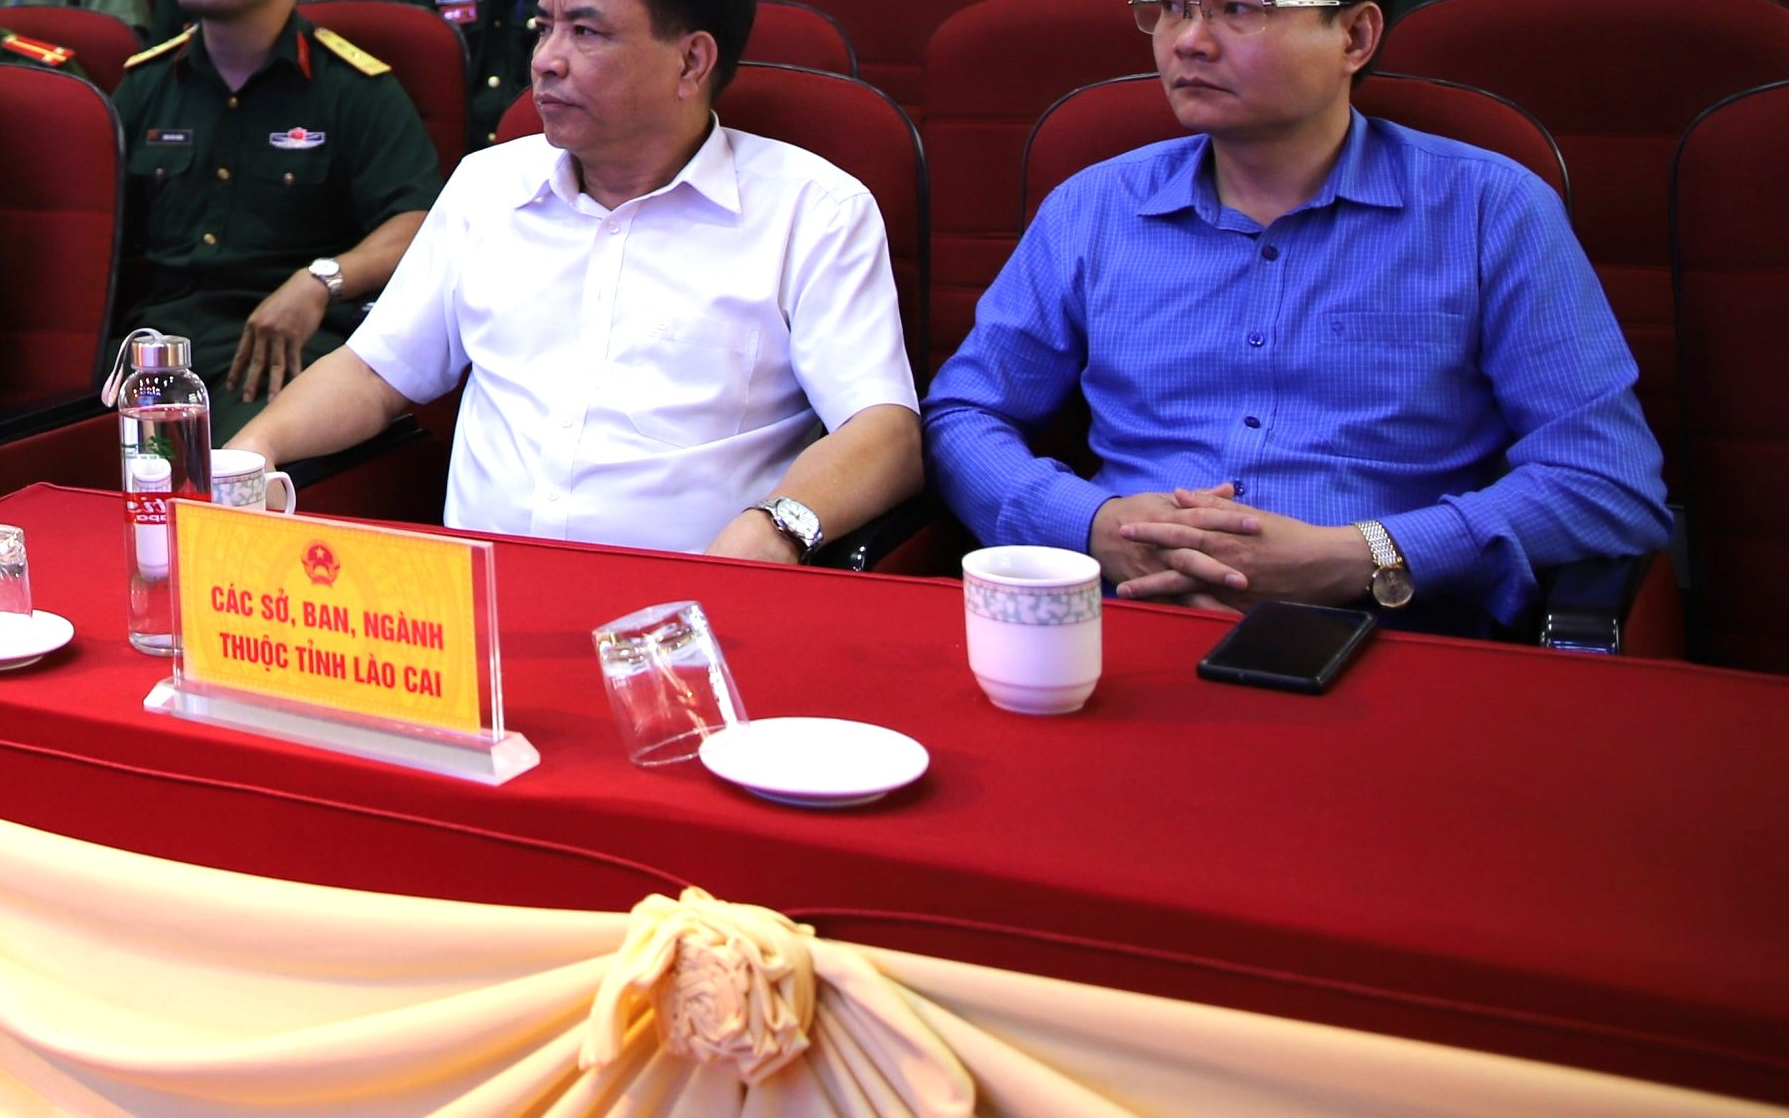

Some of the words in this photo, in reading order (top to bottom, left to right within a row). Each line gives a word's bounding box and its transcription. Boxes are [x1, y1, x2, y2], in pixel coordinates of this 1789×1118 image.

[210, 583, 255, 618] CÁC
[260, 587, 297, 628] SỞ,
[302, 600, 357, 639] BAN,
[363, 608, 445, 652] NGÀNH
[218, 631, 290, 673] THUỘC
[294, 639, 348, 682] TỈNH
[353, 652, 397, 691] LÀO
[402, 665, 443, 700] CAI
